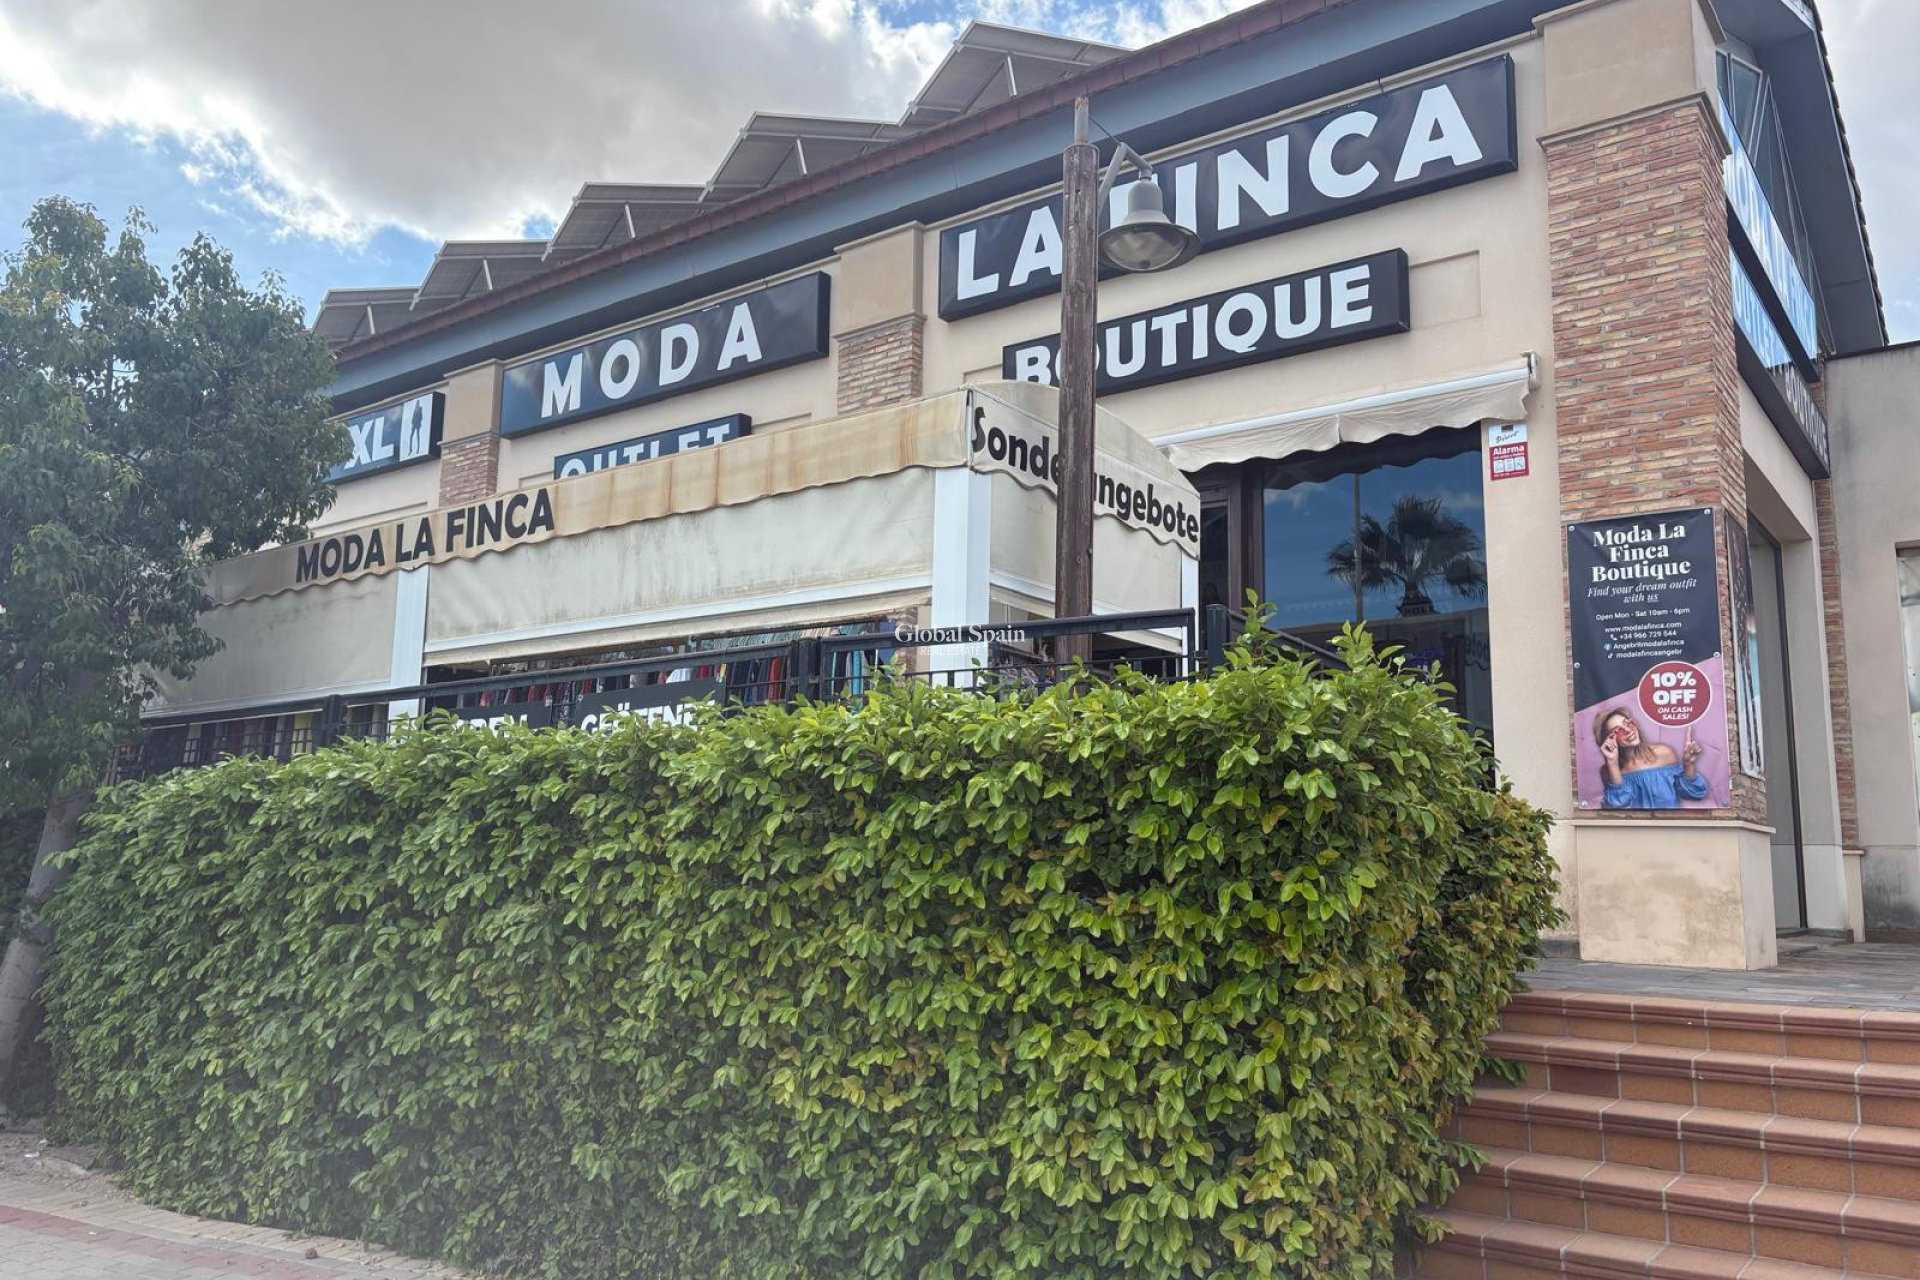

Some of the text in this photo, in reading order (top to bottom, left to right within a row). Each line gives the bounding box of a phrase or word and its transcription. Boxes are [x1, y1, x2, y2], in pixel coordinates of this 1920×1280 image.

[957, 205, 1062, 301] LA
[541, 301, 763, 420] MODA
[1494, 446, 1524, 455] Alarma
[971, 406, 1199, 543] Sondengebote
[296, 488, 555, 583] MODA LA FINCA
[1593, 523, 1686, 547] Moda La
[1609, 544, 1669, 563] Finca
[1591, 560, 1692, 582] Boutique
[1587, 578, 1697, 598] Find your dream outfit
[1623, 593, 1659, 603] with us
[1674, 607, 1690, 615] 6pm
[1605, 622, 1682, 633] www.modalafinca.com
[1650, 671, 1697, 688] 10%
[1653, 688, 1697, 705] OFF
[1657, 706, 1670, 714] ON
